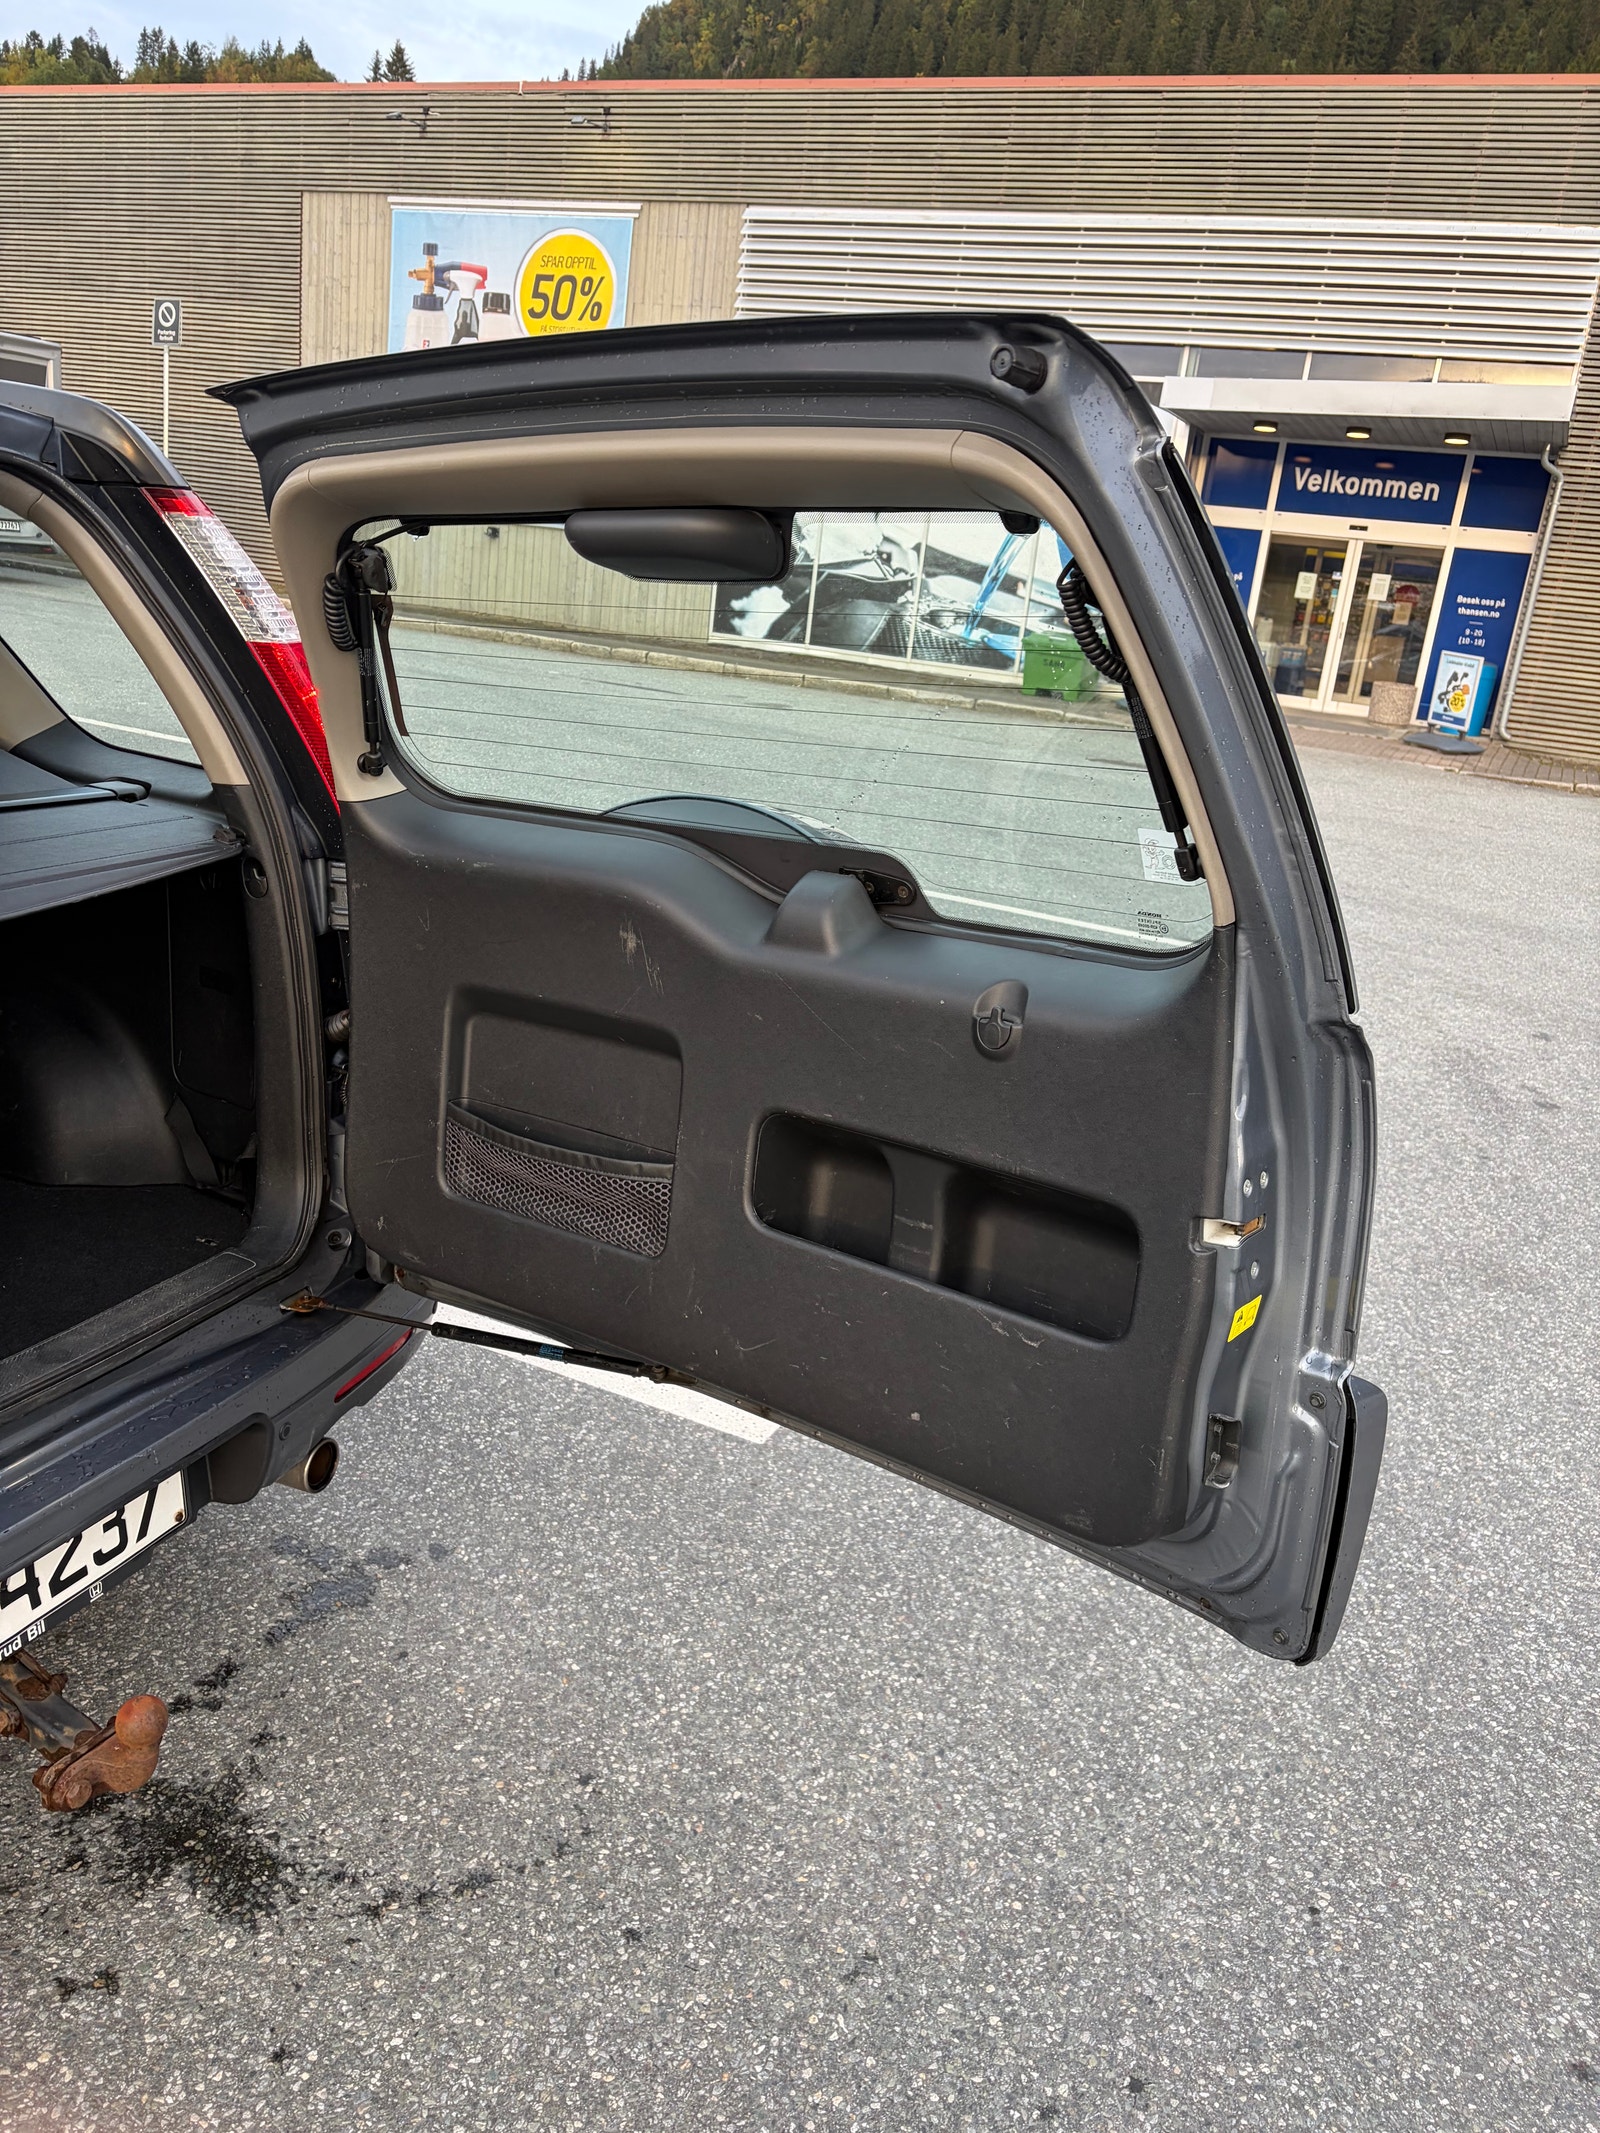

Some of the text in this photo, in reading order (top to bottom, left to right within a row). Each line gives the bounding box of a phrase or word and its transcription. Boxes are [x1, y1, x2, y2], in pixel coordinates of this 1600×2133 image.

[540, 254, 597, 270] SPAR OPPTIL
[527, 273, 605, 322] 50%
[1294, 466, 1440, 502] Velkommen
[1457, 606, 1500, 618] thansen.no
[27, 1620, 46, 1642] Bil
